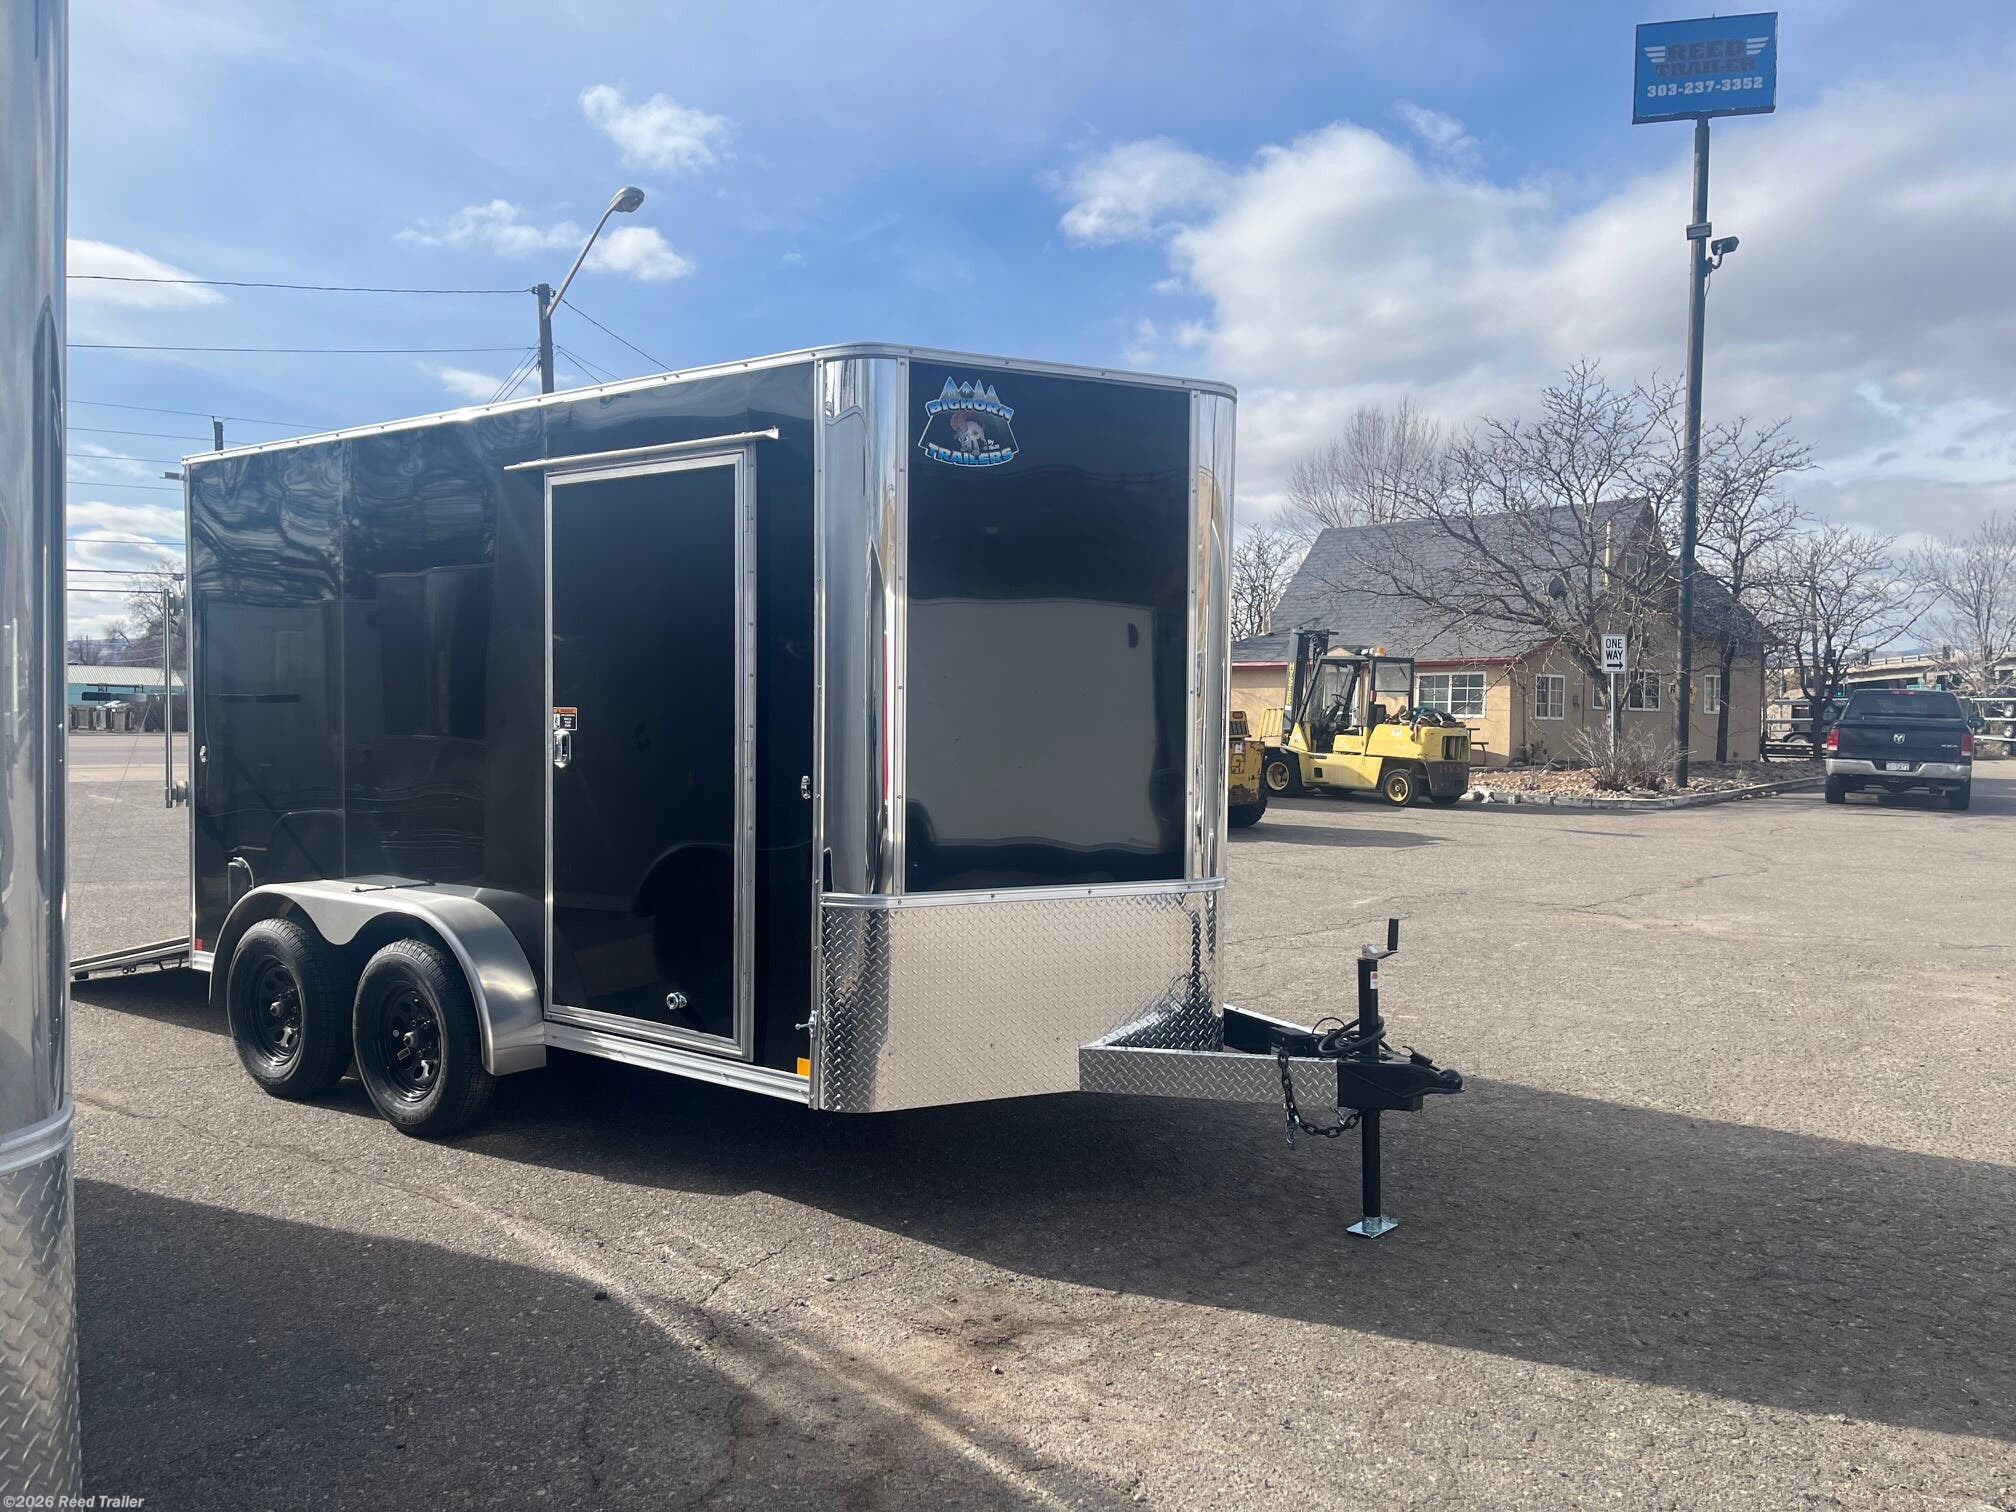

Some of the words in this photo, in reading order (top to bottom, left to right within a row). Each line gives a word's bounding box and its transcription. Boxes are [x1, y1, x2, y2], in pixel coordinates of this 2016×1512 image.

[1666, 39, 1746, 62] REED
[1647, 76, 1764, 98] 303-237-3352
[928, 397, 1013, 422] BIGHORN
[926, 443, 1014, 465] TRAILERS
[1605, 638, 1623, 649] ONE
[1605, 650, 1623, 660] WAY
[1286, 662, 1295, 705] HYSTER
